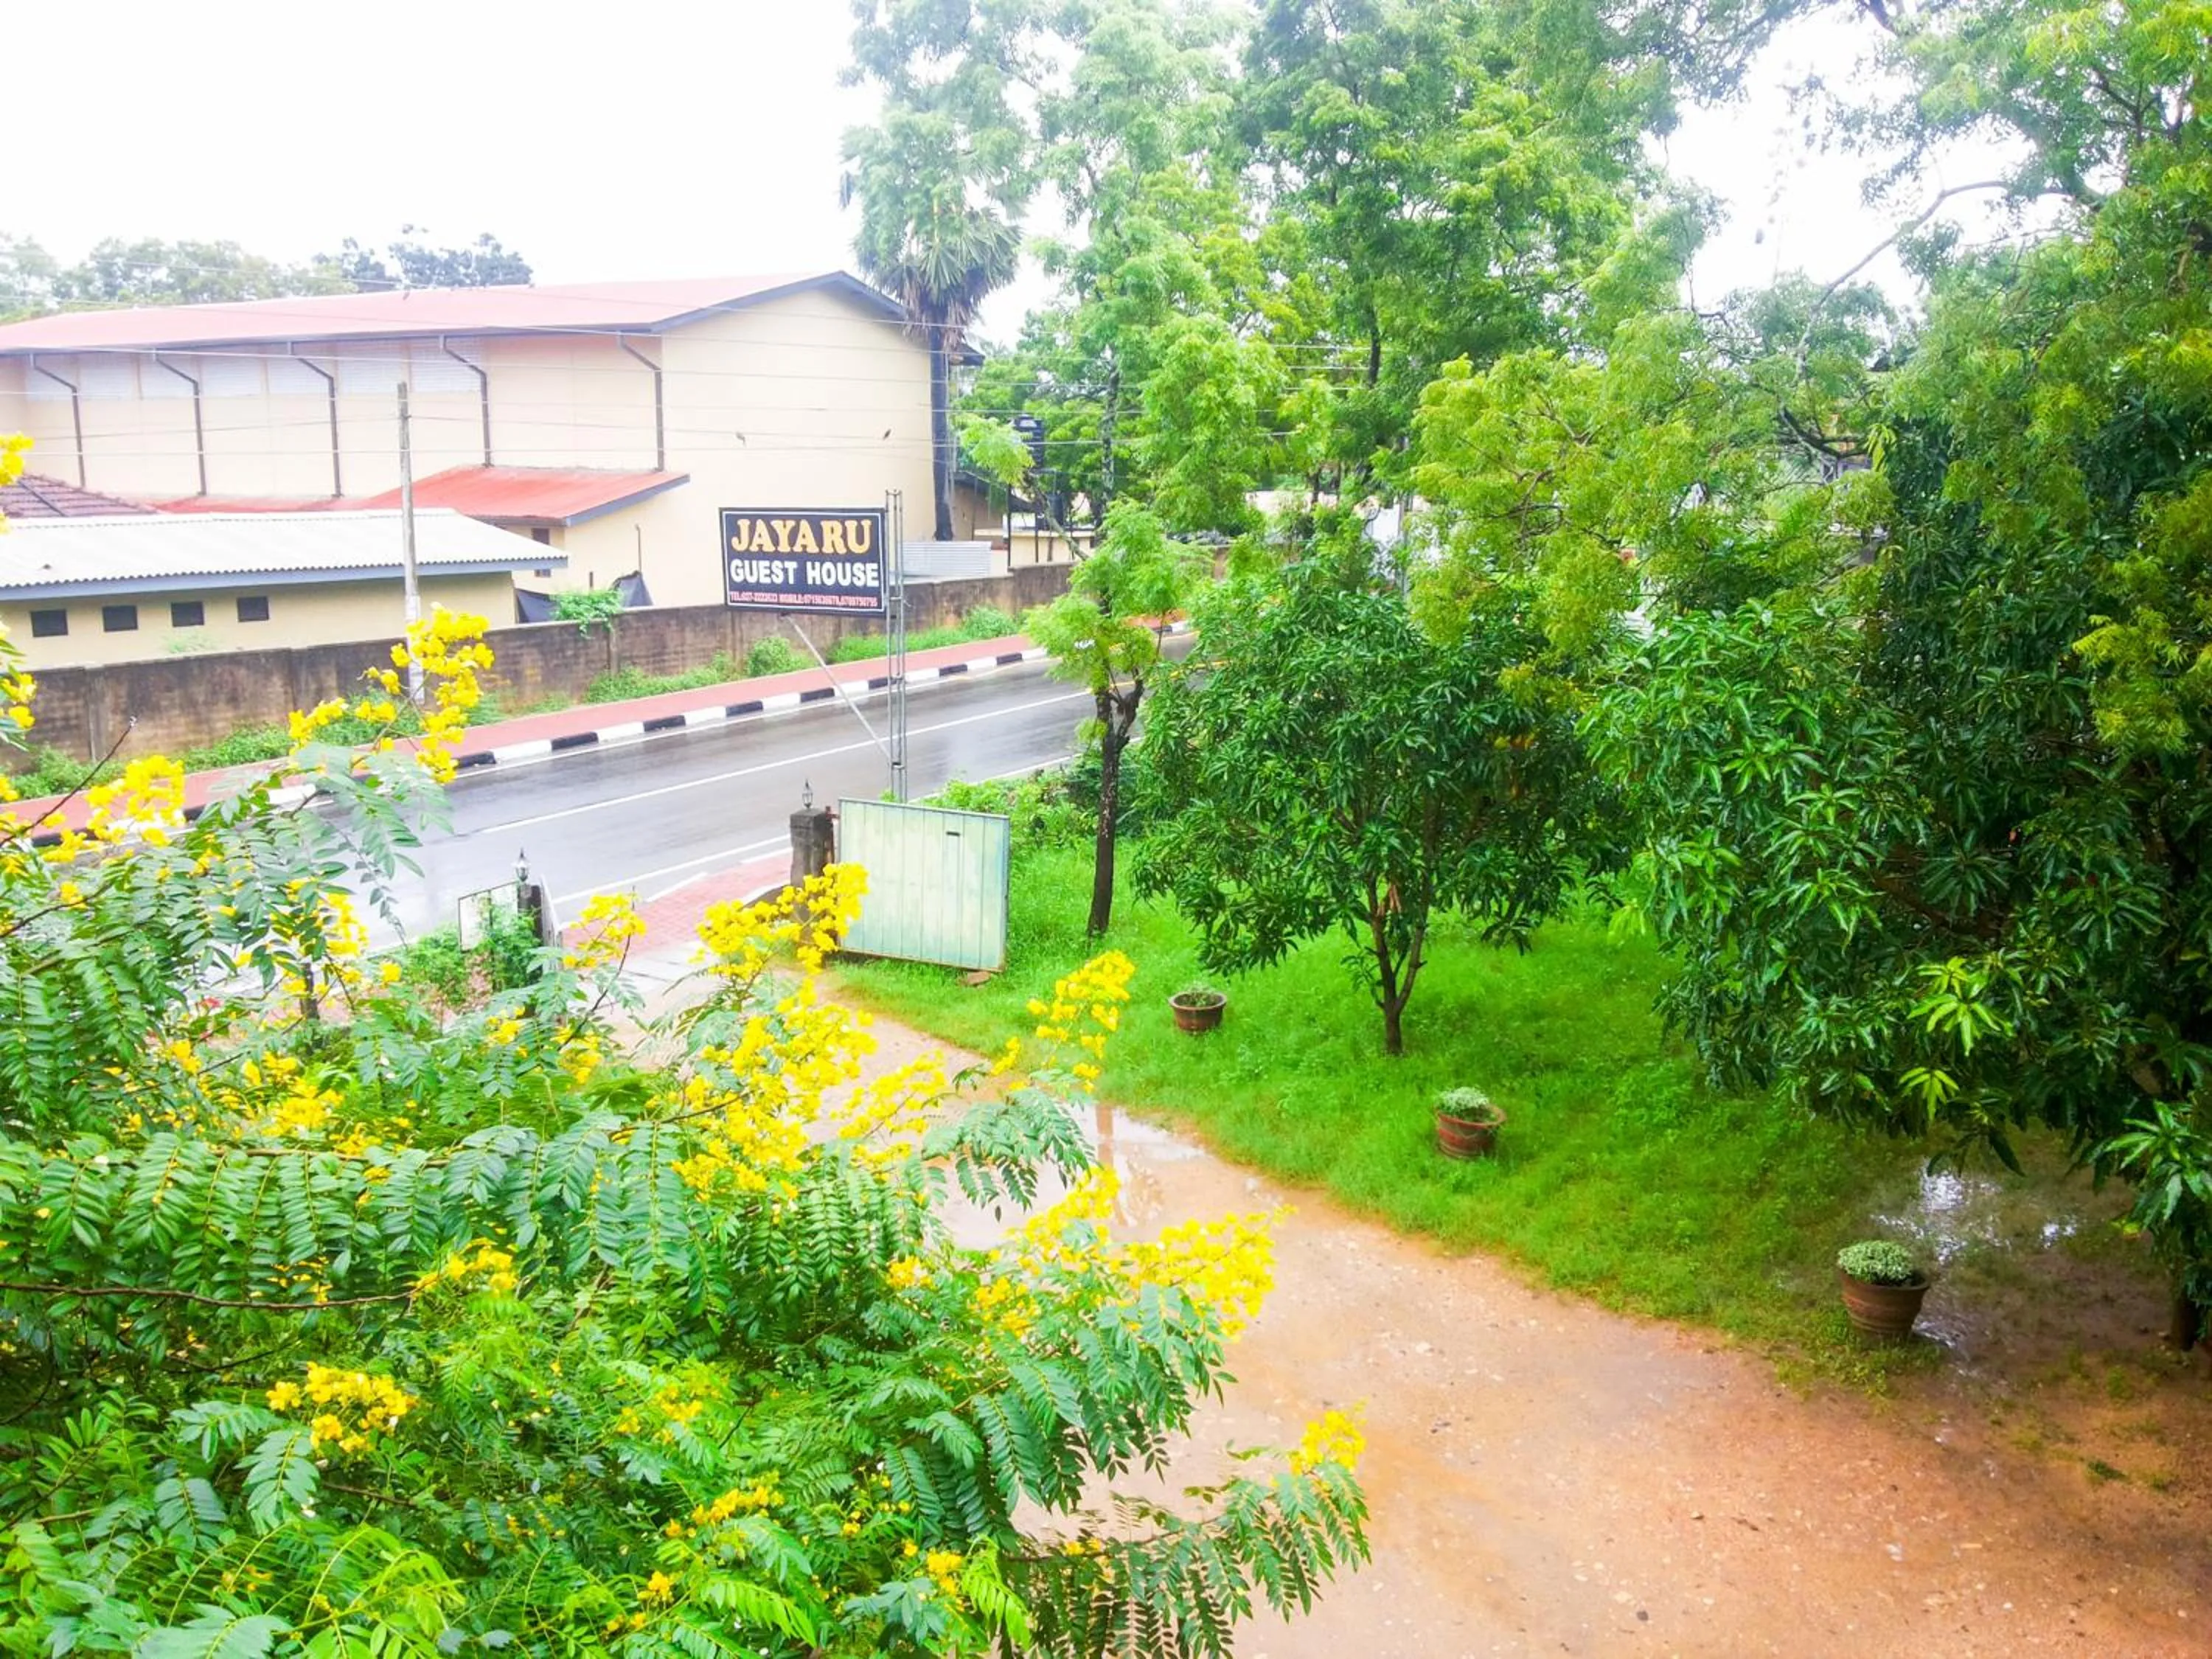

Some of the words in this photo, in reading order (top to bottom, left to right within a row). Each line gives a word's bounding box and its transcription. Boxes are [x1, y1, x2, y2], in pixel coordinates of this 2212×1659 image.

[731, 518, 872, 554] JAYARU
[730, 558, 799, 585] GUEST
[806, 560, 880, 587] HOUSE
